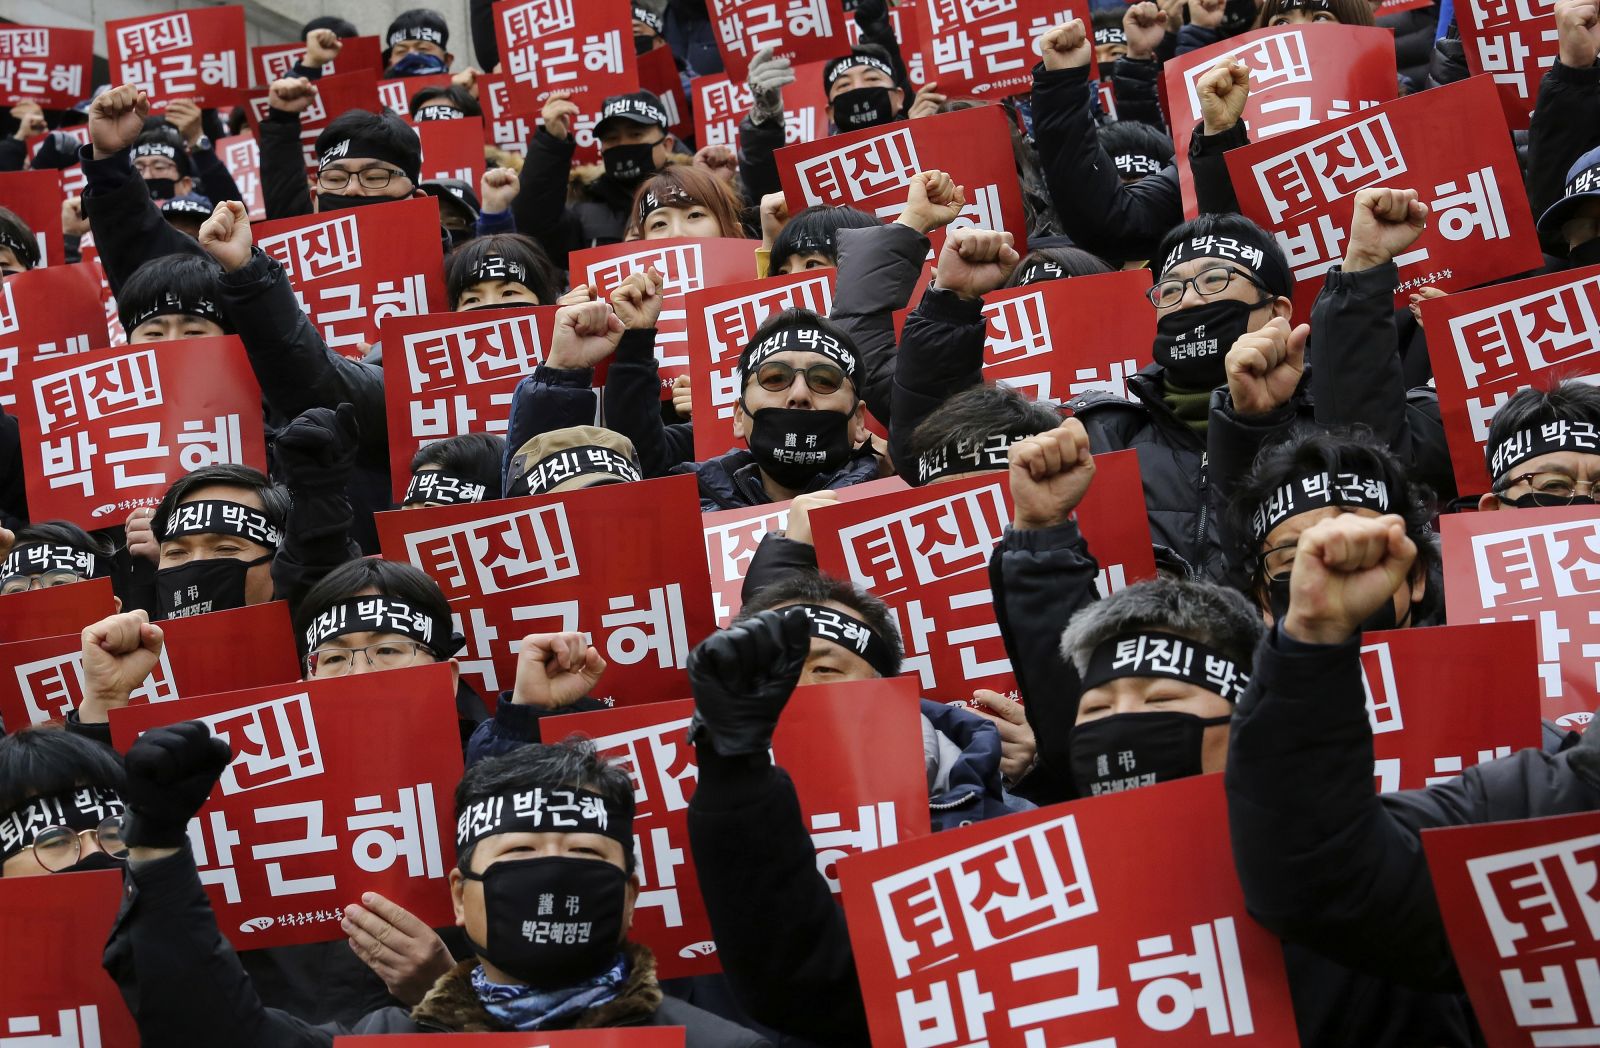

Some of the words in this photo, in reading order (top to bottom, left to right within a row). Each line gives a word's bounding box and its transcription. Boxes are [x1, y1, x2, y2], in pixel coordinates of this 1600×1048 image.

[116, 13, 193, 61] 퇴진!
[502, 0, 575, 48] 퇴진!
[716, 0, 833, 57] 박근혜
[1094, 28, 1127, 43] 박근
[121, 50, 237, 97] 박근혜
[508, 30, 624, 89] 박근혜
[795, 128, 922, 207] 퇴진!
[1252, 111, 1407, 224] 퇴진!
[1191, 235, 1264, 270] 박근혜
[1393, 268, 1453, 294] 공무원노동조합
[748, 331, 789, 370] 퇴진!
[797, 329, 856, 376] 박근혜
[980, 290, 1053, 369] 진!
[1170, 338, 1218, 360] 박근혜정권
[403, 314, 543, 395] 퇴진!
[32, 349, 163, 434] 퇴진!
[40, 413, 244, 498] 박근혜
[772, 447, 827, 464] 박근혜정권
[957, 433, 1034, 467] 박근
[1492, 429, 1532, 478] 퇴진!
[1541, 419, 1600, 448] 박근
[418, 473, 486, 503] 박근혜
[527, 452, 580, 496] 퇴진!
[1301, 472, 1389, 511] 박근혜
[118, 496, 166, 510] 전국공무원노
[165, 504, 212, 536] 퇴진!
[222, 505, 284, 548] 박근혜
[0, 552, 20, 579] 진!
[28, 544, 96, 578] 박근혜
[404, 502, 581, 604] 퇴진!
[837, 482, 1010, 600] 퇴진!
[306, 606, 346, 652] 퇴진!
[357, 600, 433, 643] 박근혜
[785, 606, 871, 653] 근혜
[1112, 635, 1194, 676] 퇴진!
[200, 692, 324, 797] 진!
[0, 797, 67, 852] 퇴진!
[457, 796, 504, 846] 퇴진!
[513, 787, 608, 831] 박근혜
[277, 907, 344, 927] 전국공무원노동
[872, 814, 1099, 979] 퇴진!
[521, 920, 593, 945] 박근혜정권
[896, 916, 1256, 1048] 박근혜
